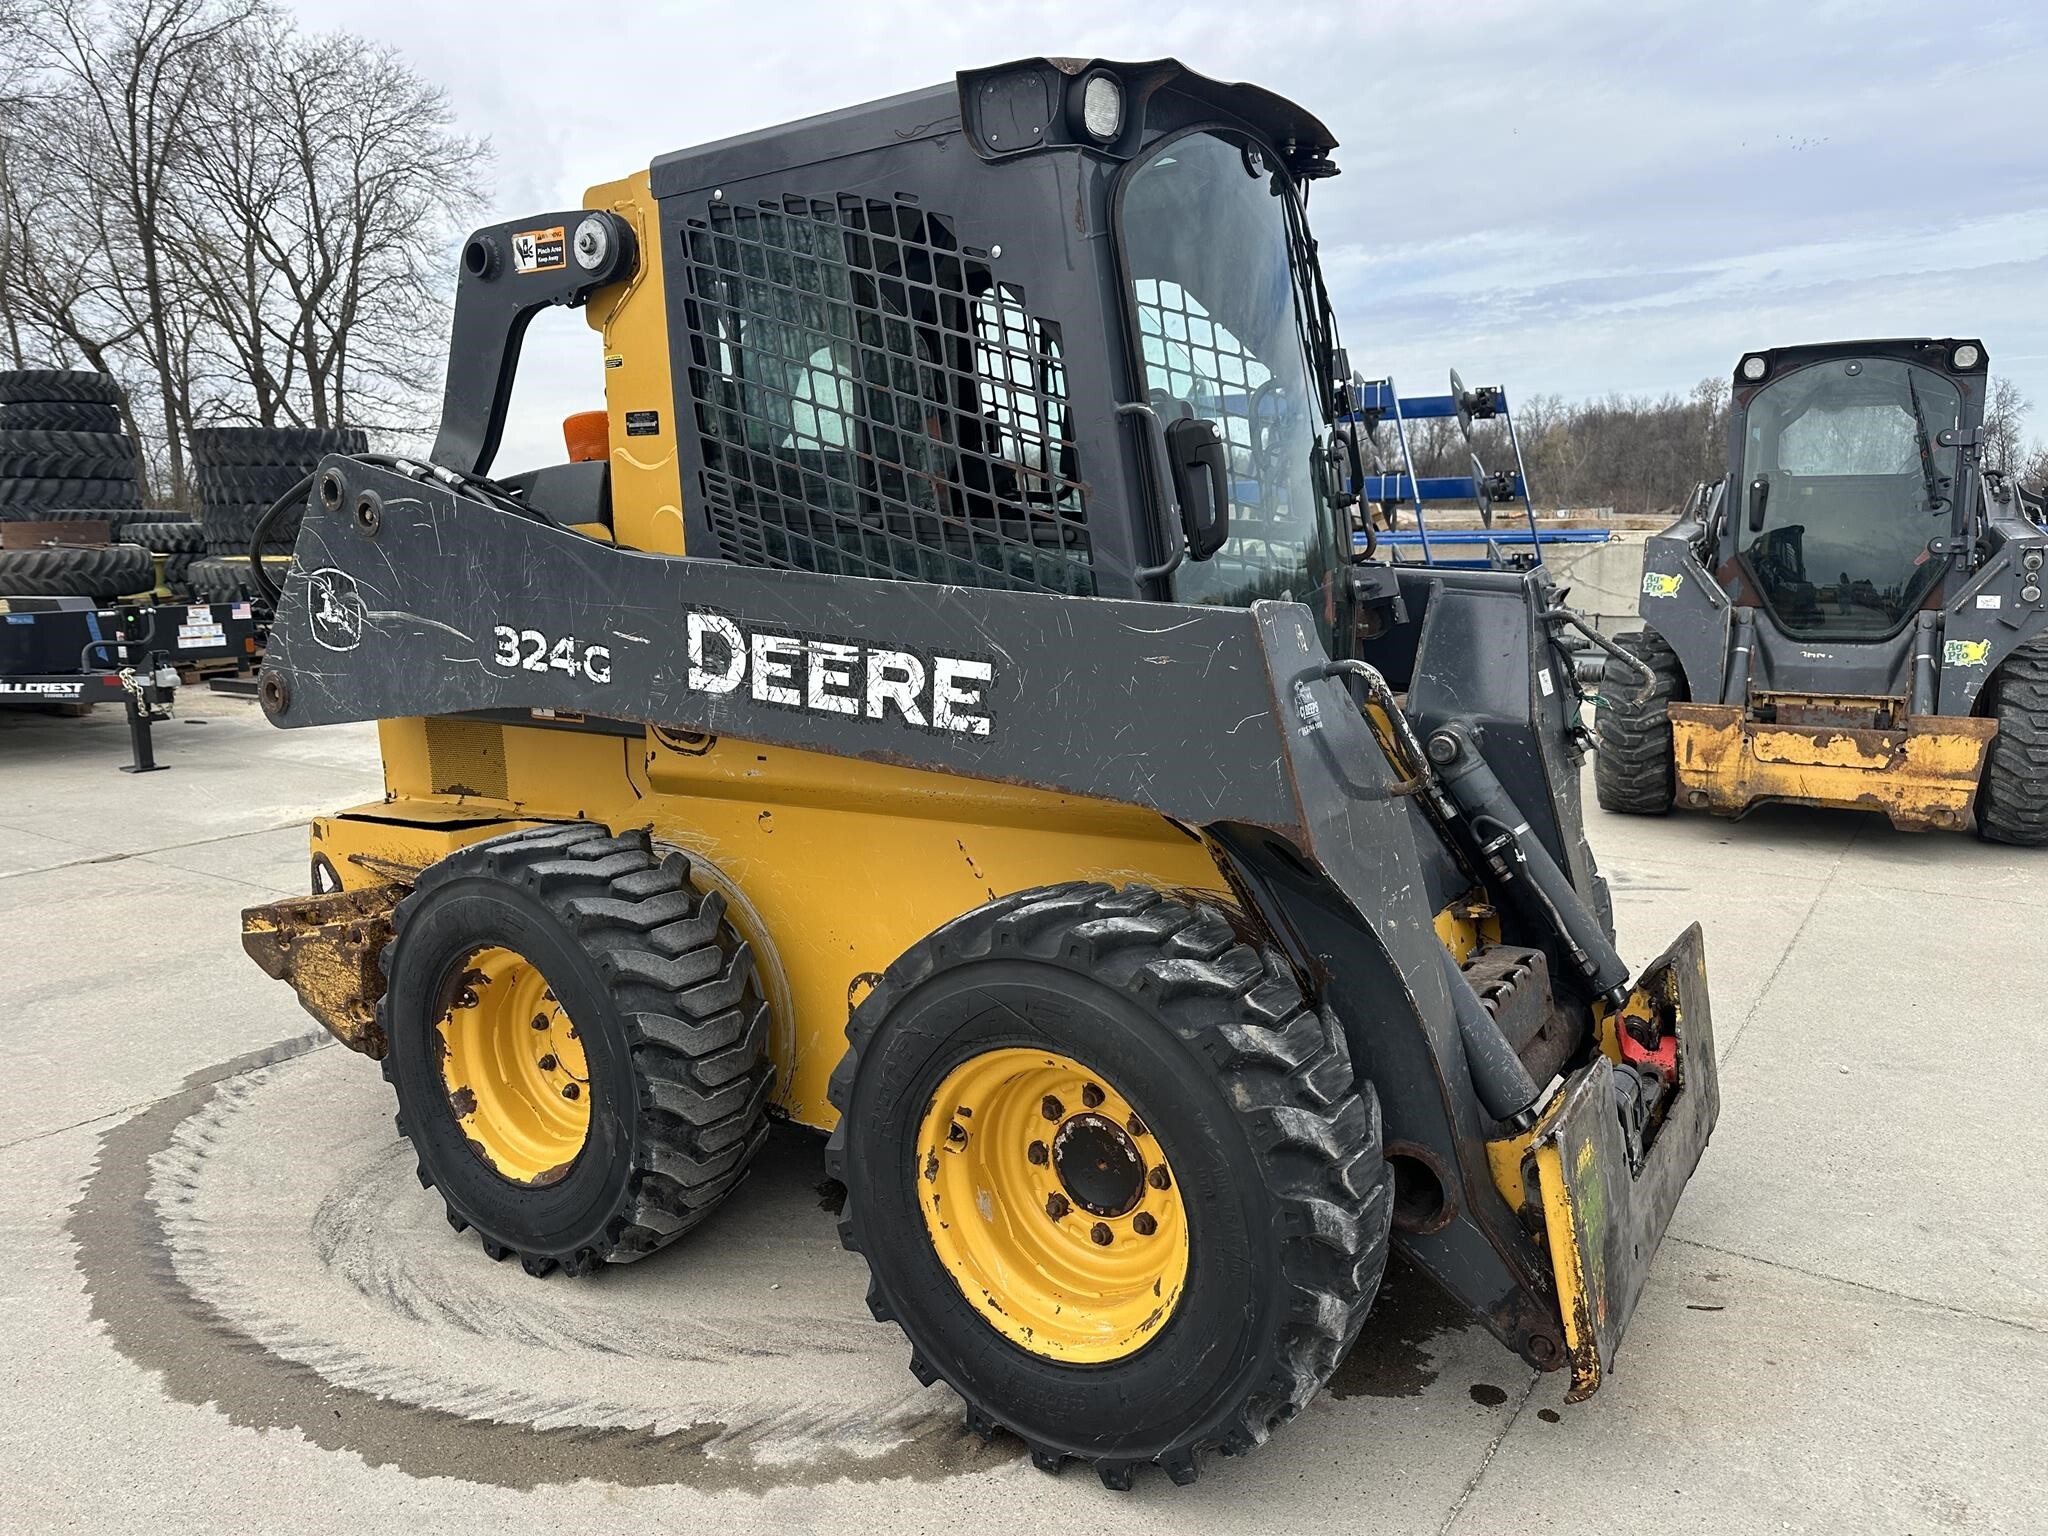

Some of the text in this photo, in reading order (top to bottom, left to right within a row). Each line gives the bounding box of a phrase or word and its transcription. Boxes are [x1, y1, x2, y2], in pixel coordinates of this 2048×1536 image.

[537, 247, 550, 255] Pinch
[1645, 583, 1663, 592] Pro
[494, 625, 611, 683] 324G
[1948, 651, 1969, 661] Pro
[687, 613, 992, 736] DEERE
